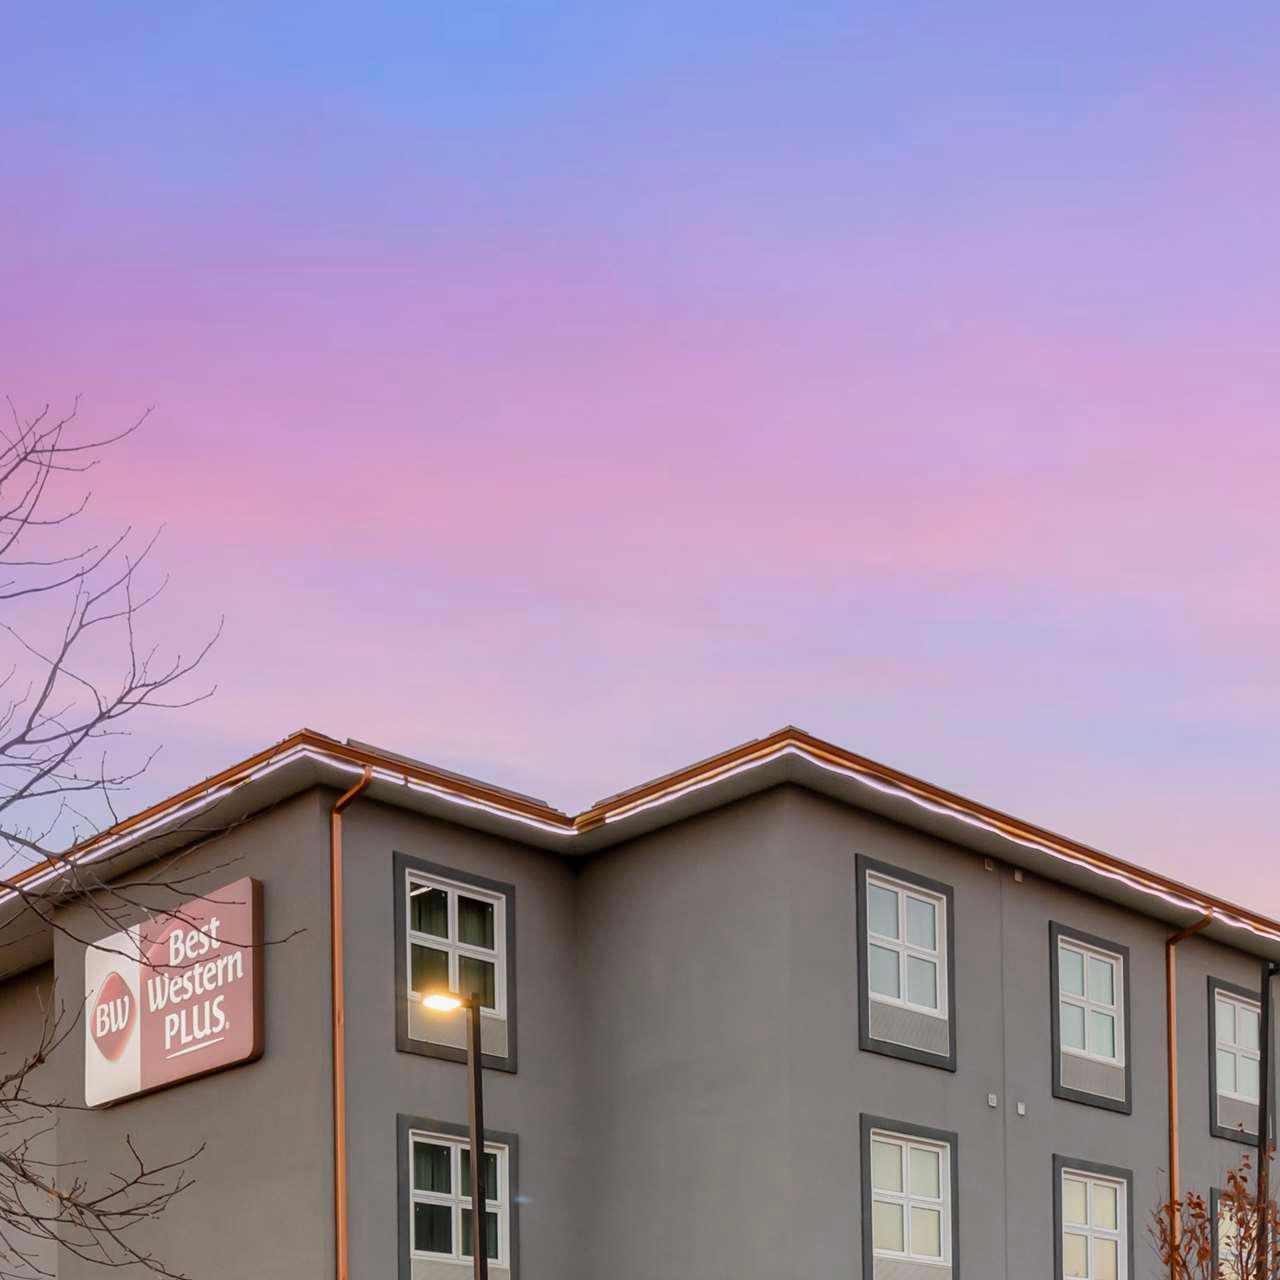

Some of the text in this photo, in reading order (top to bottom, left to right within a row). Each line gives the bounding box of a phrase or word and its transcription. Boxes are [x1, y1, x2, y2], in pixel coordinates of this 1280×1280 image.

[170, 917, 221, 966] Best
[147, 950, 244, 1012] Western
[96, 995, 129, 1037] BW
[165, 995, 226, 1050] PLUS
